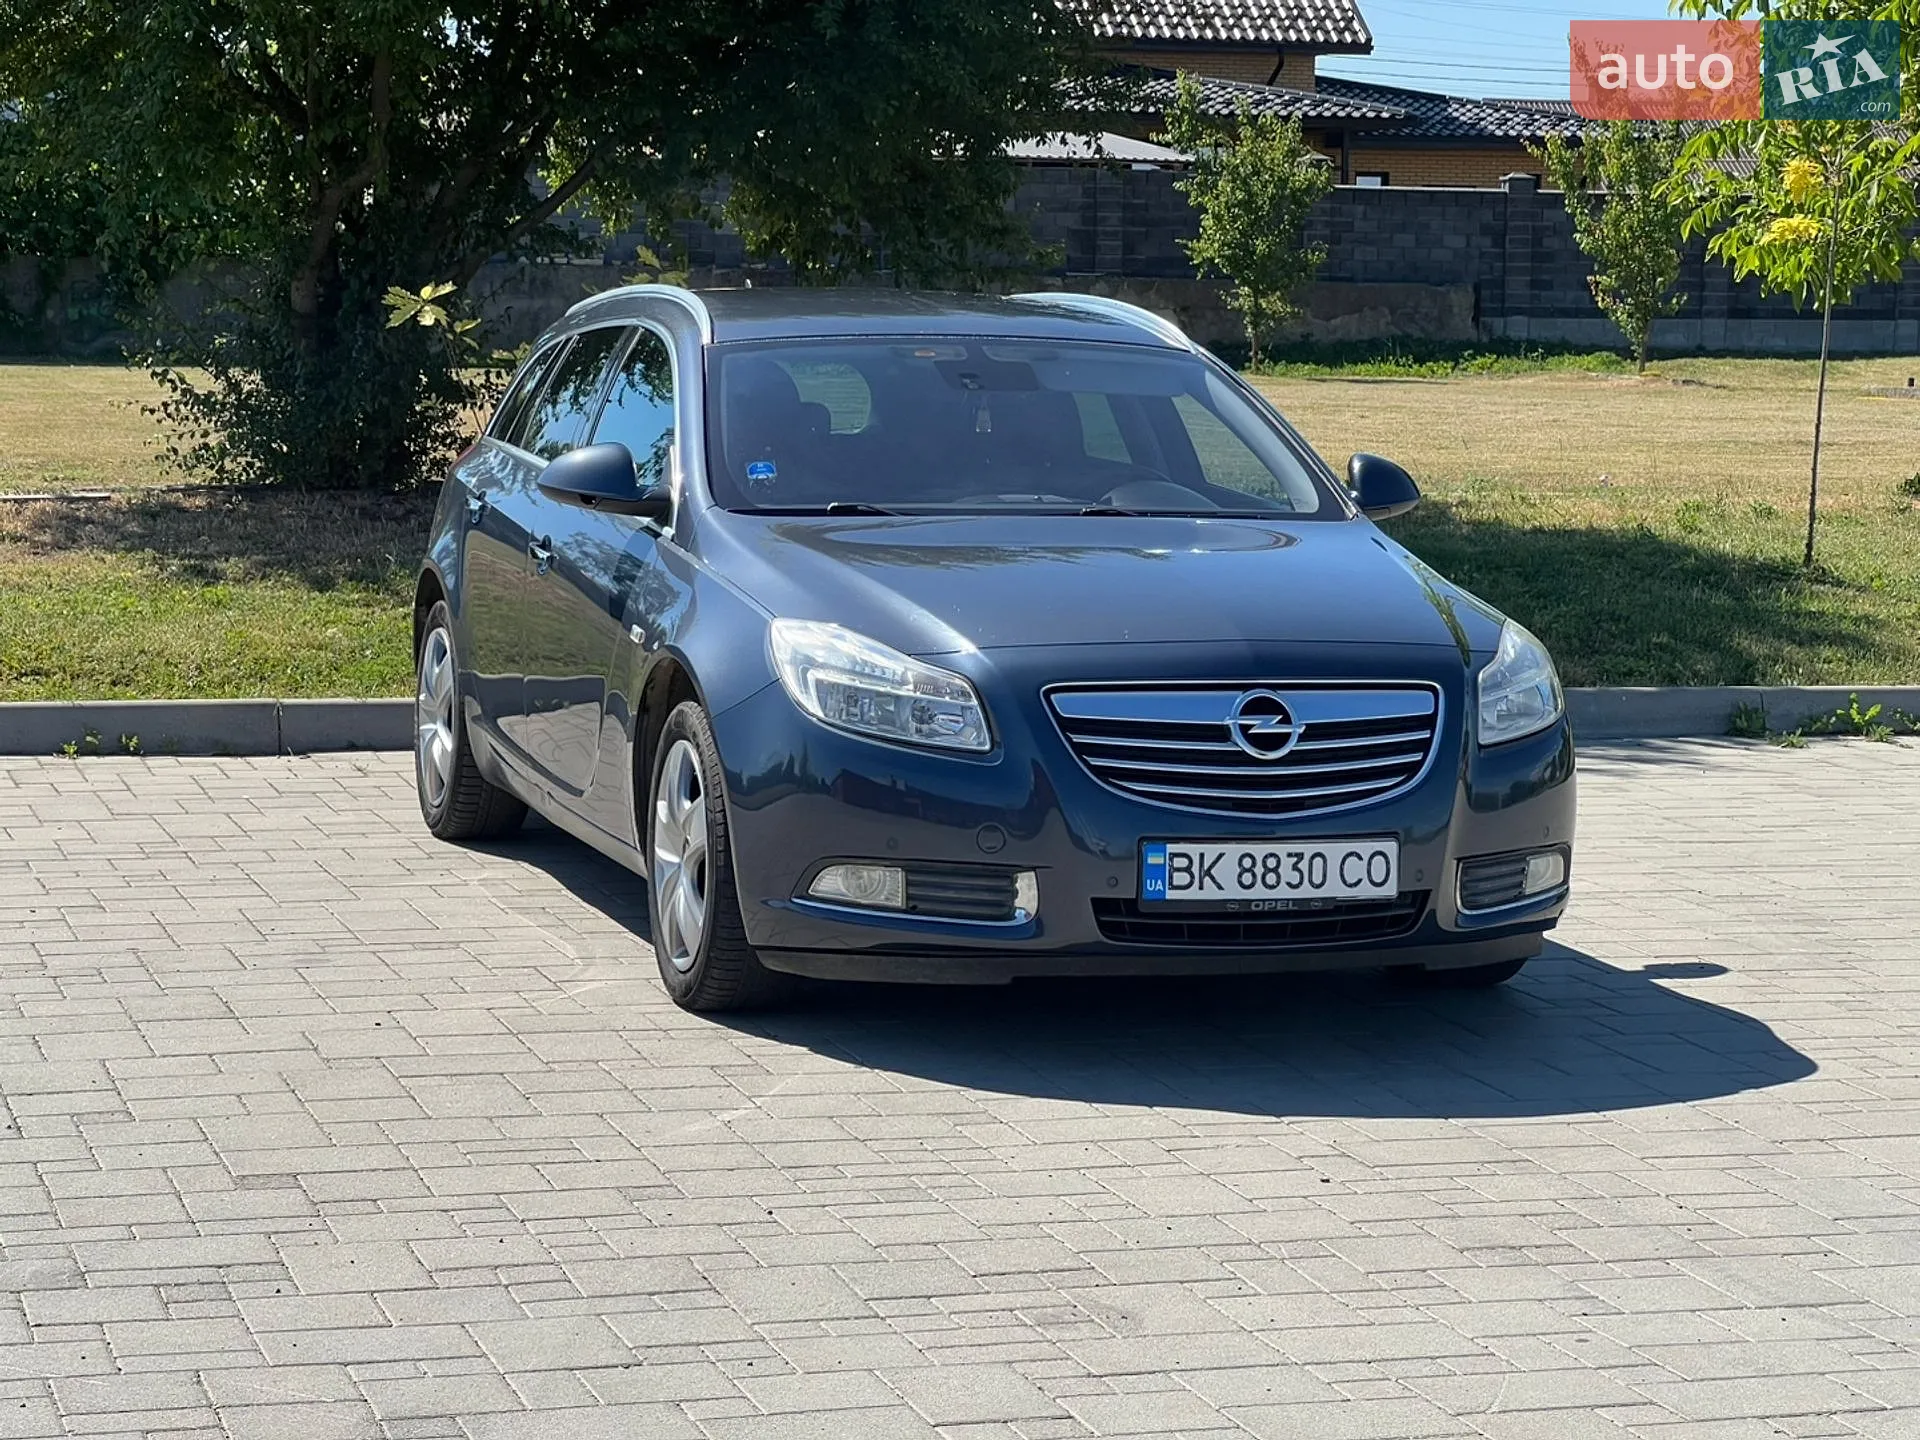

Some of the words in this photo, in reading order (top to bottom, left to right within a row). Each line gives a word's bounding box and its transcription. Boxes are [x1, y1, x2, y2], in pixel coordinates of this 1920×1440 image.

[1167, 851, 1226, 891] BK
[1236, 851, 1328, 891] 8830
[1338, 850, 1392, 889] CO
[1146, 879, 1164, 892] UA
[1250, 900, 1299, 911] OPEL
